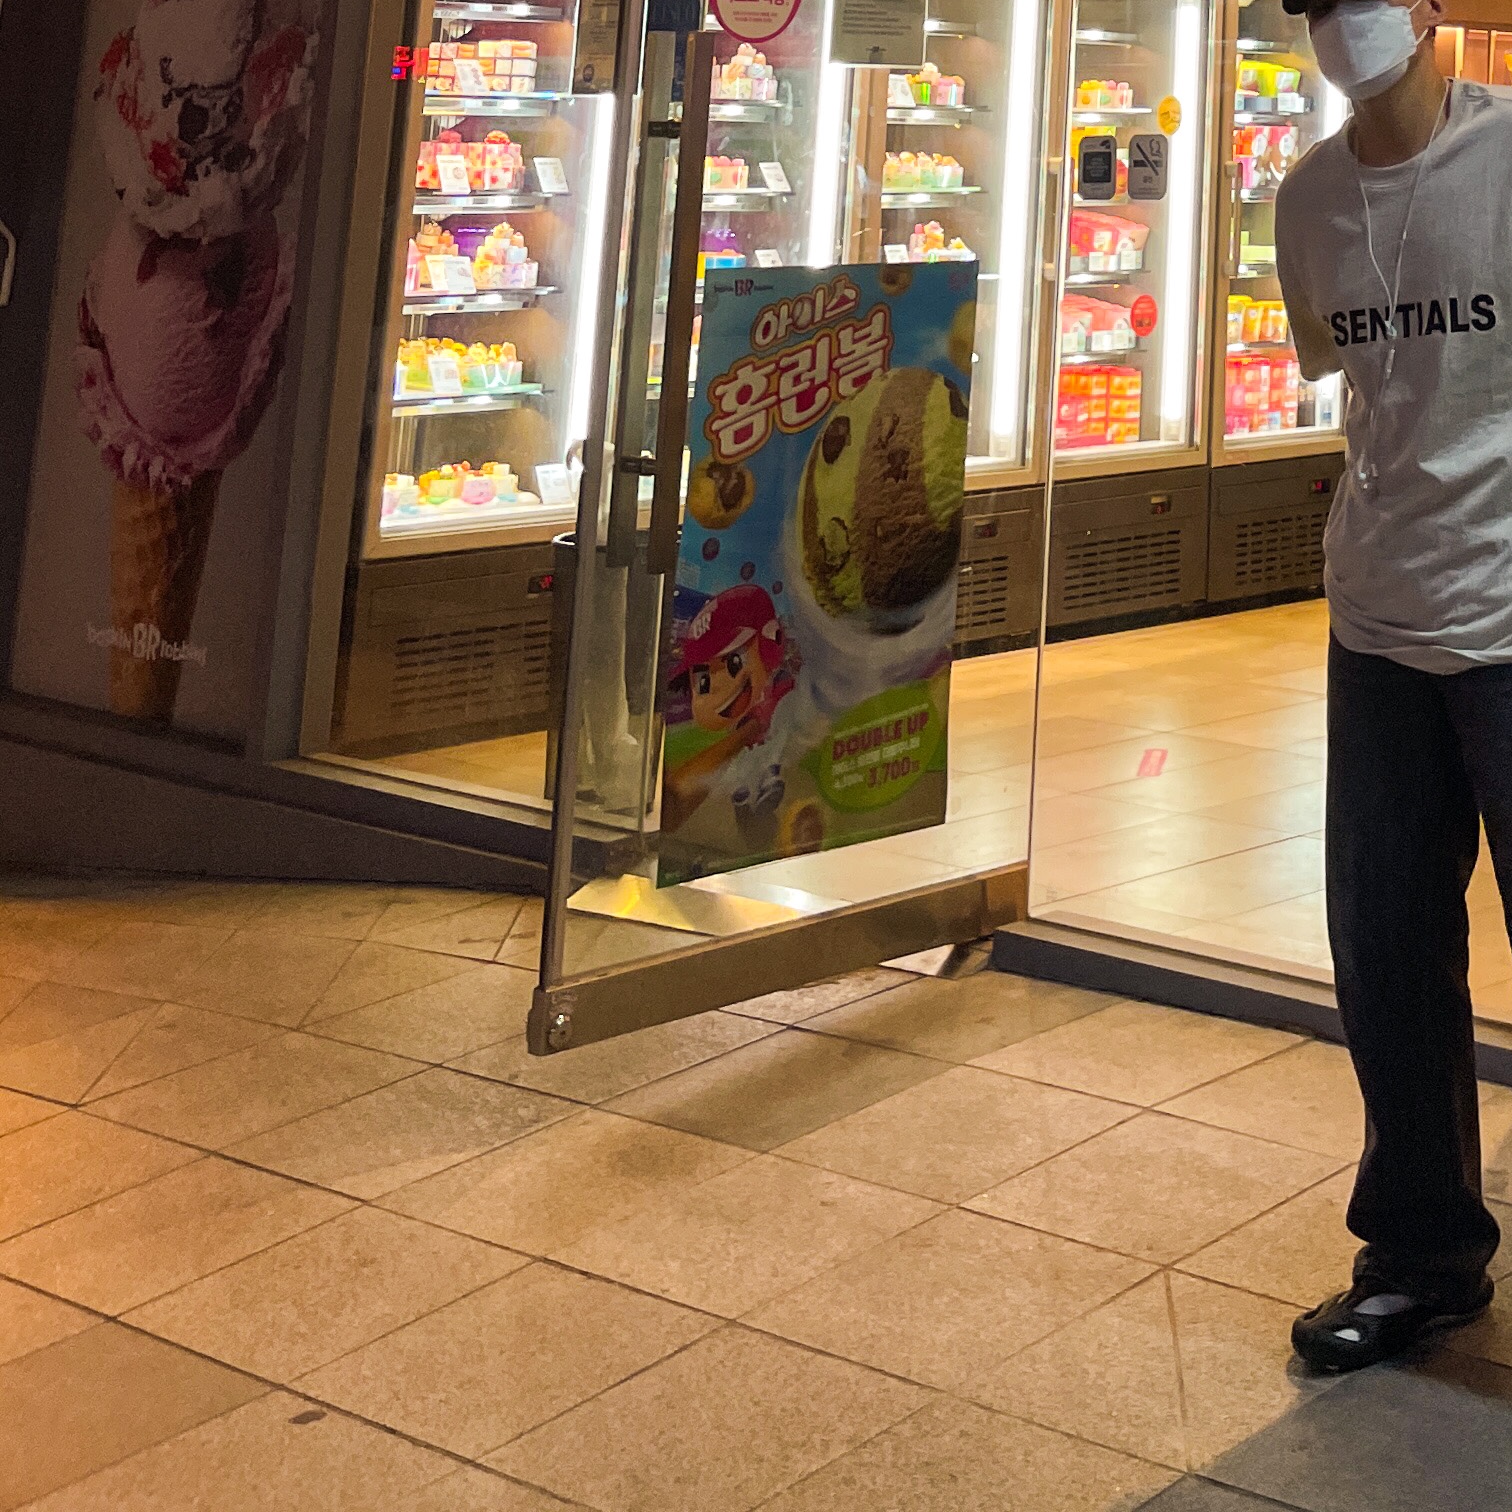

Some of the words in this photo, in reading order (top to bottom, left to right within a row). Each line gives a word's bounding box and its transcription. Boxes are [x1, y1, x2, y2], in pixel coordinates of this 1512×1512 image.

[753, 280, 859, 349] 아이스
[1324, 293, 1497, 348] SENTIALS
[709, 308, 892, 459] 홈런볼
[133, 622, 160, 661] BR
